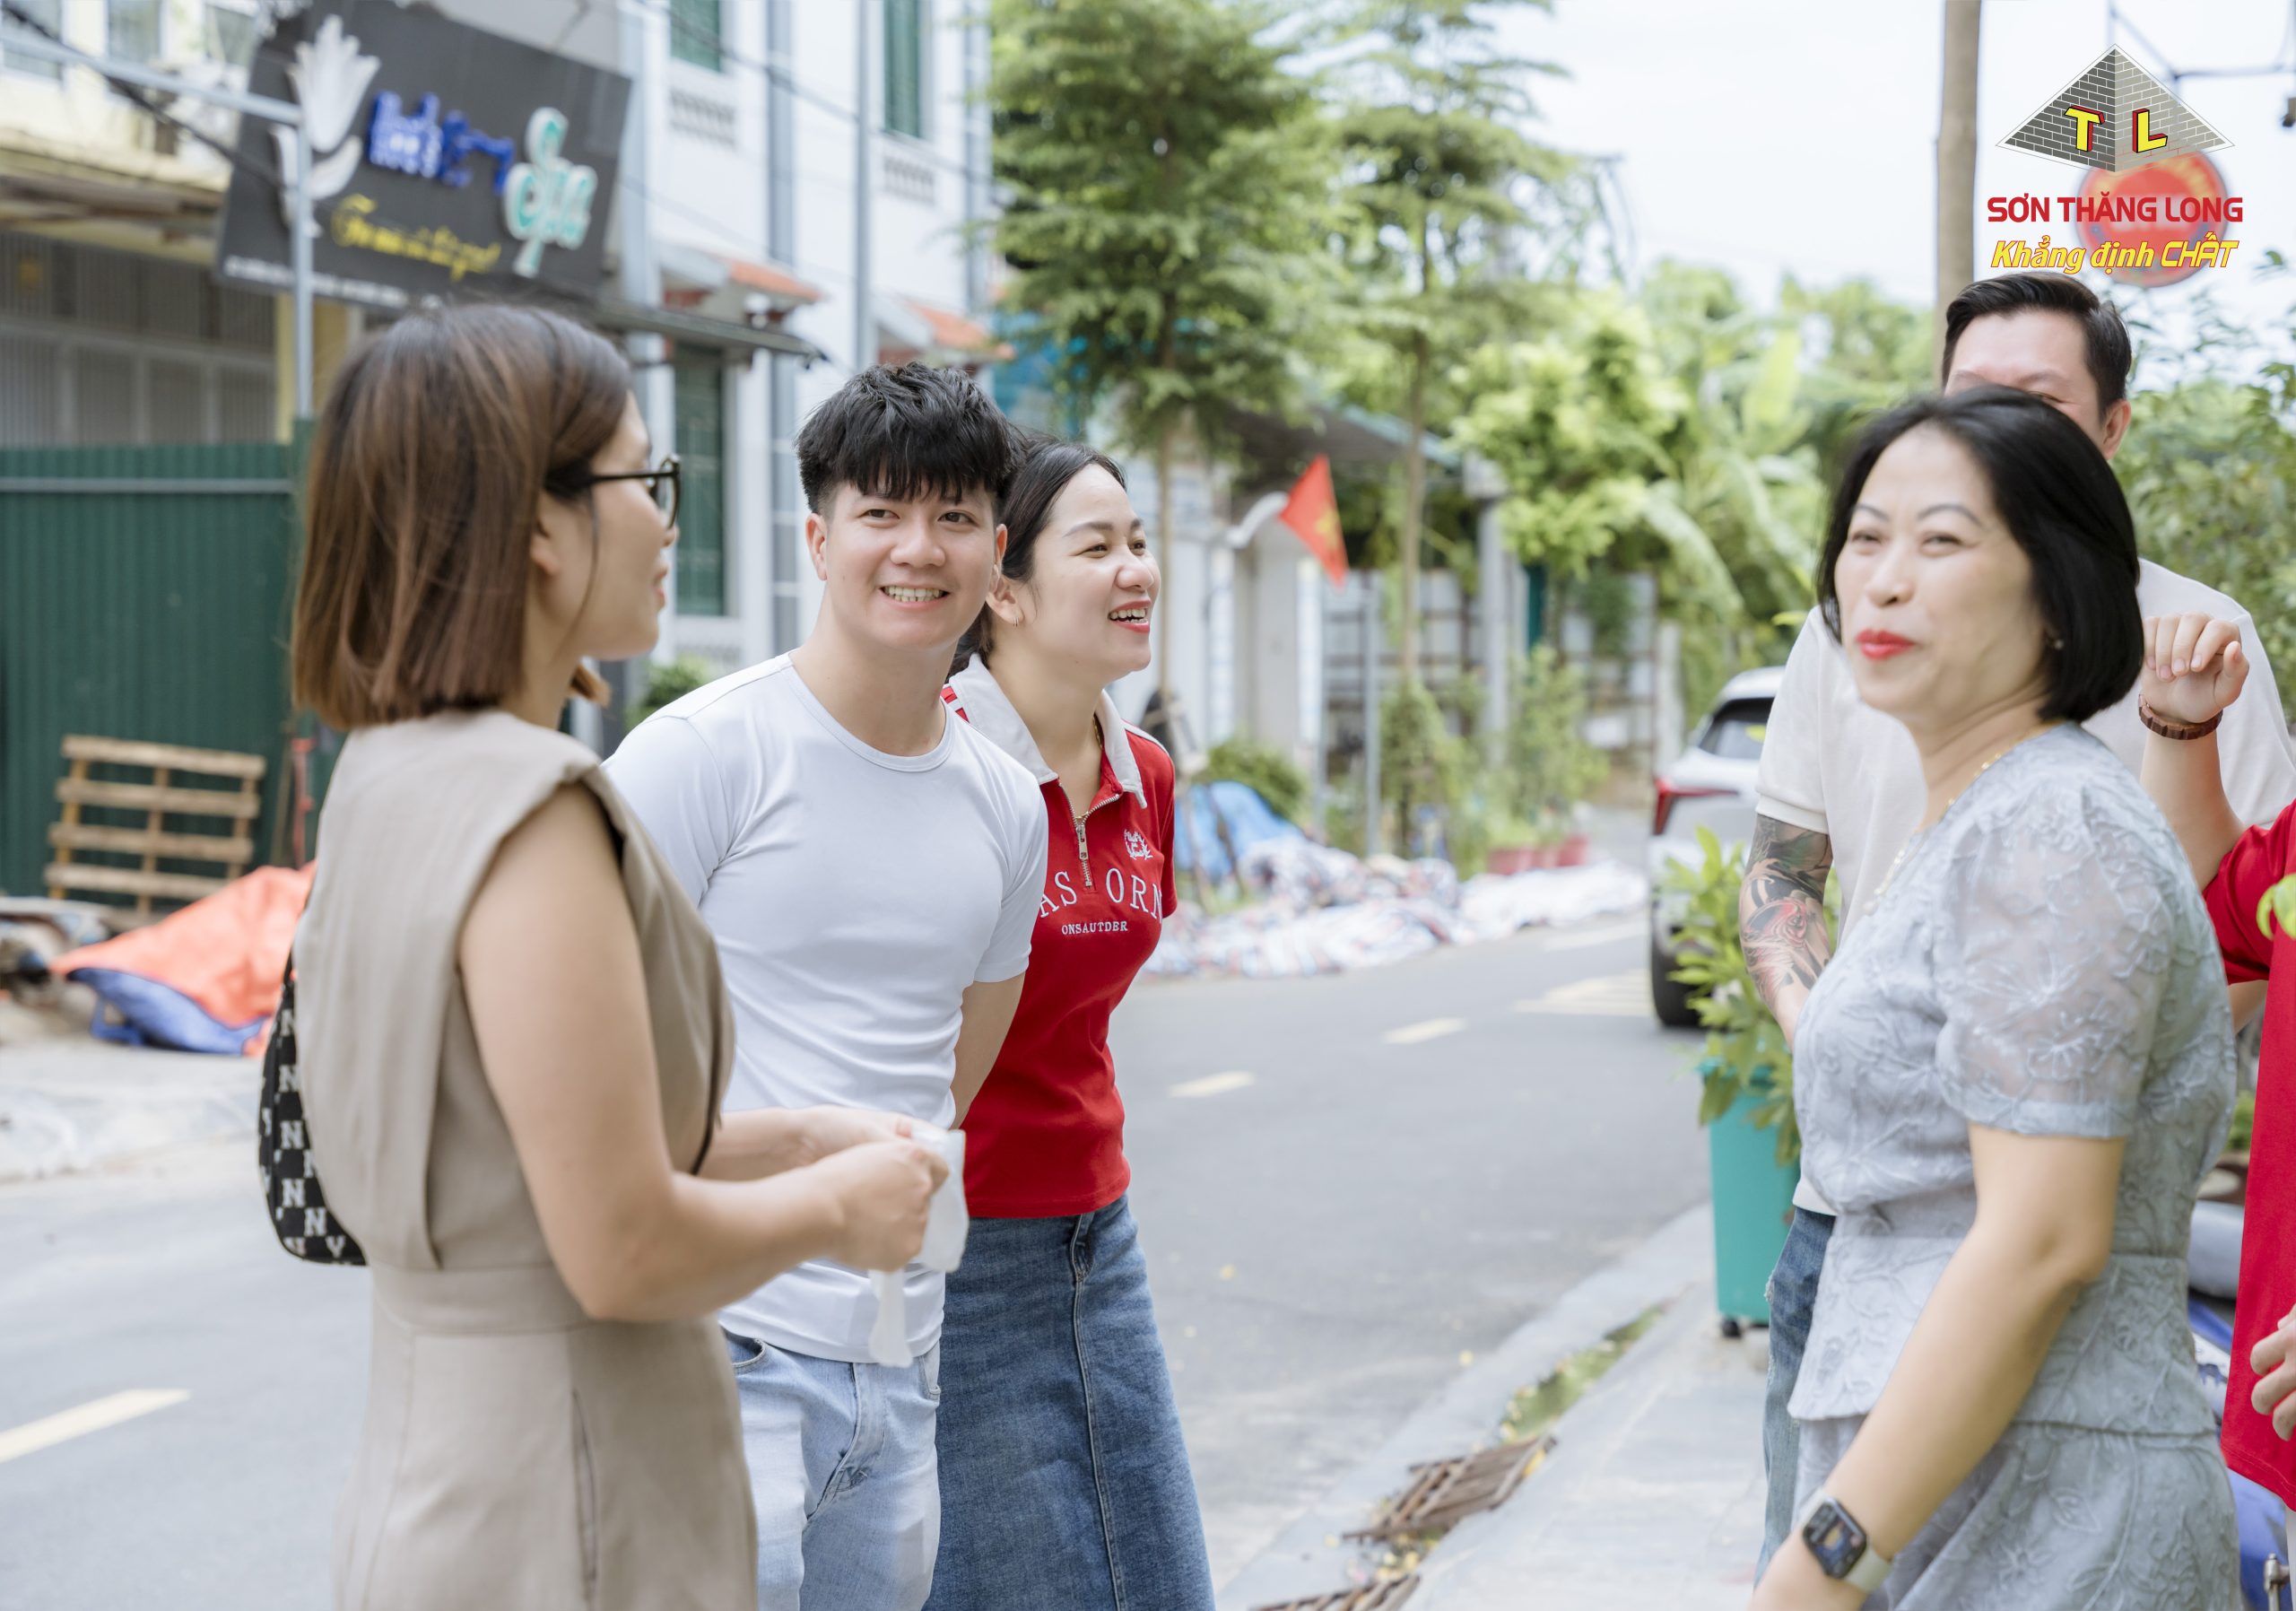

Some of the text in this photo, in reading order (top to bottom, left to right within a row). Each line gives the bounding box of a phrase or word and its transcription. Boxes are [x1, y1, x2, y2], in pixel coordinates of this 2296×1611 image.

[1061, 920, 1128, 936] ONSAUTDER
[280, 1119, 303, 1149] N
[282, 1179, 306, 1207] N
